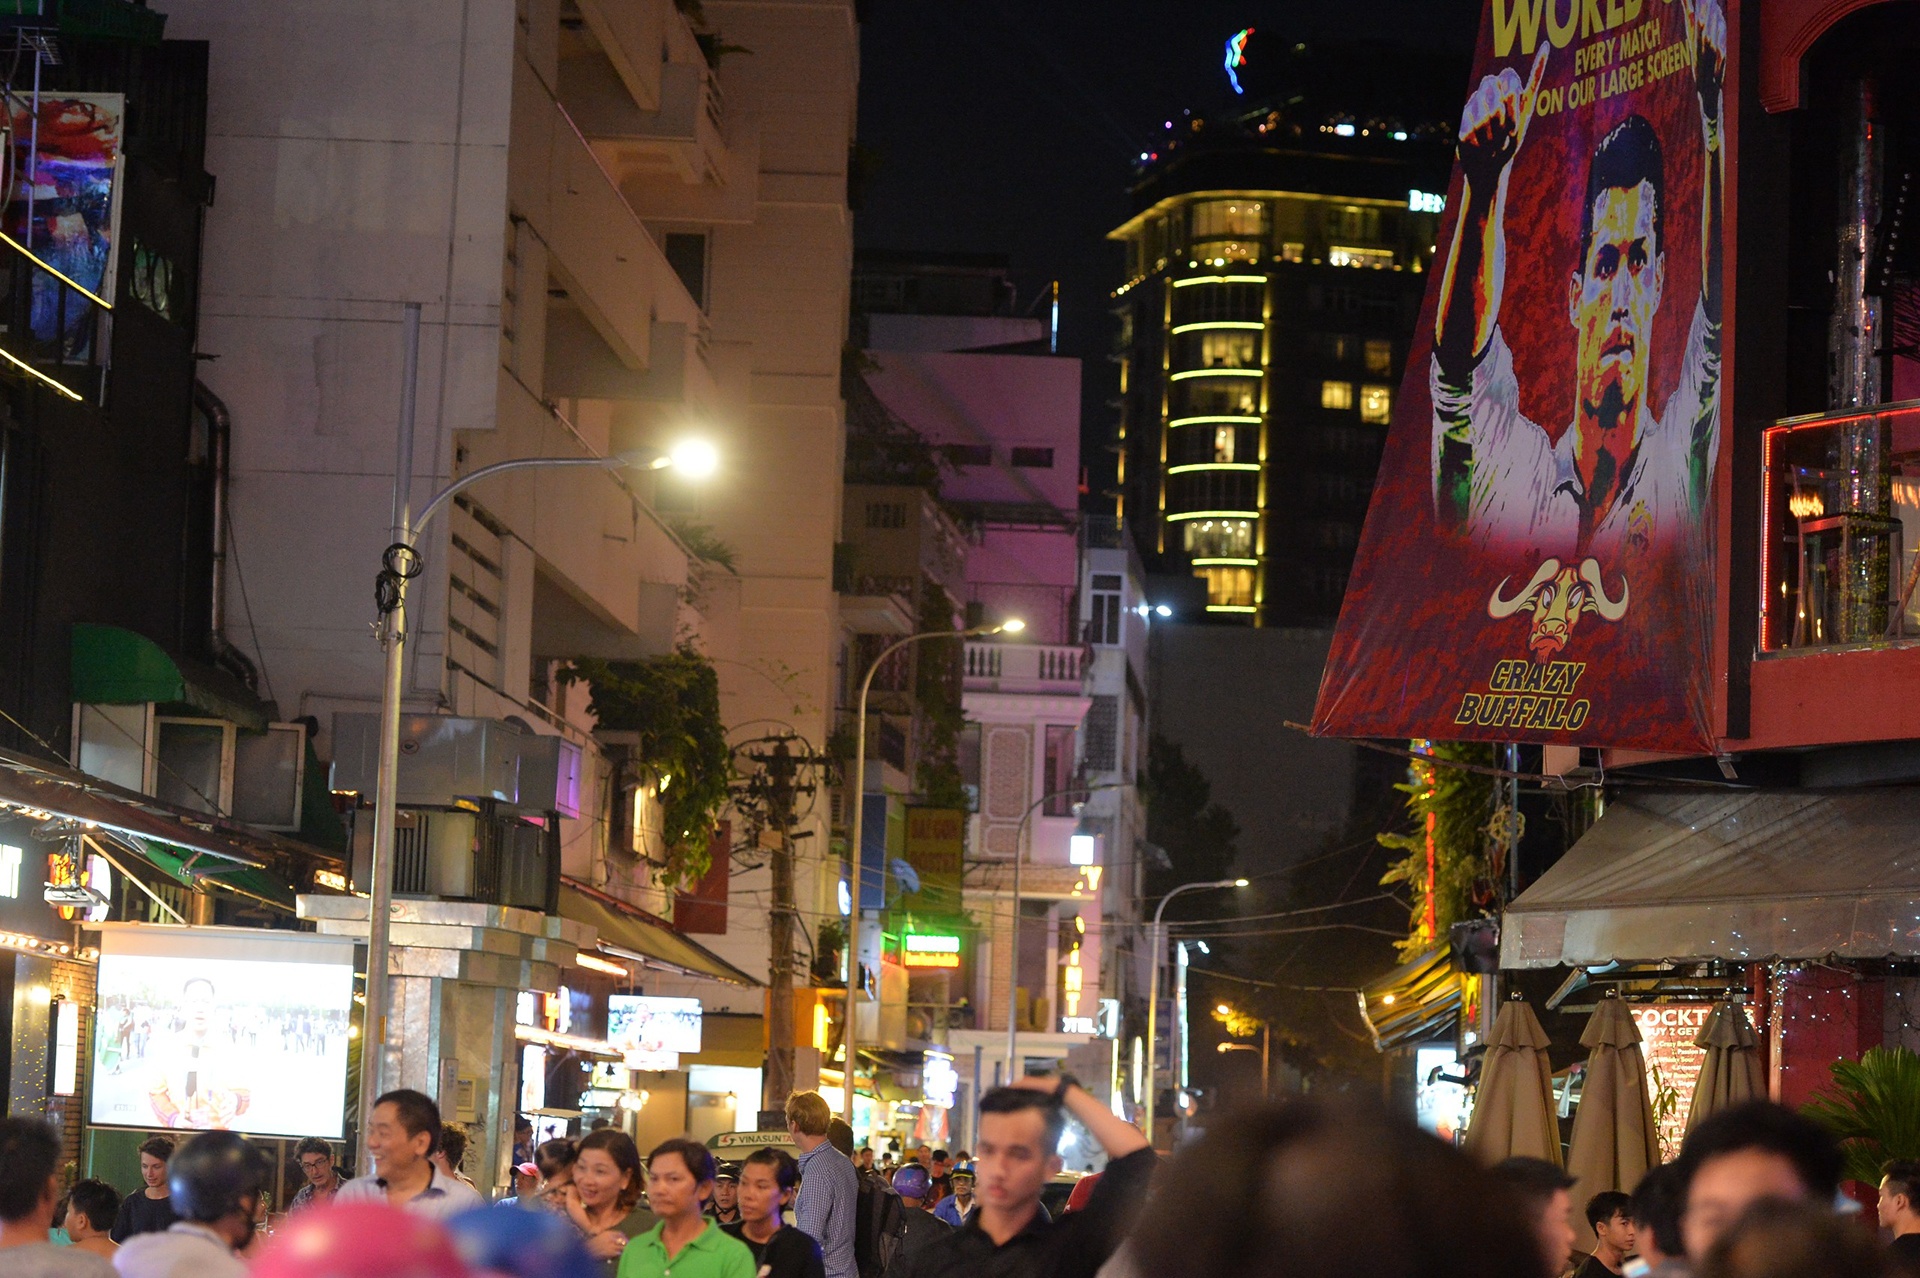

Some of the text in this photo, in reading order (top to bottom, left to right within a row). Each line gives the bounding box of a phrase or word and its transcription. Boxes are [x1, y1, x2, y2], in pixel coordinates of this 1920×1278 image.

[1575, 18, 1661, 76] EVERY MATCH
[1536, 38, 1691, 117] ON OUR LARGE SCREEN
[1489, 660, 1586, 695] CRAZY
[1454, 693, 1590, 731] BUFFALO
[1669, 1027, 1676, 1036] 2
[1678, 1027, 1700, 1036] GET
[739, 1134, 782, 1144] VINASUN
